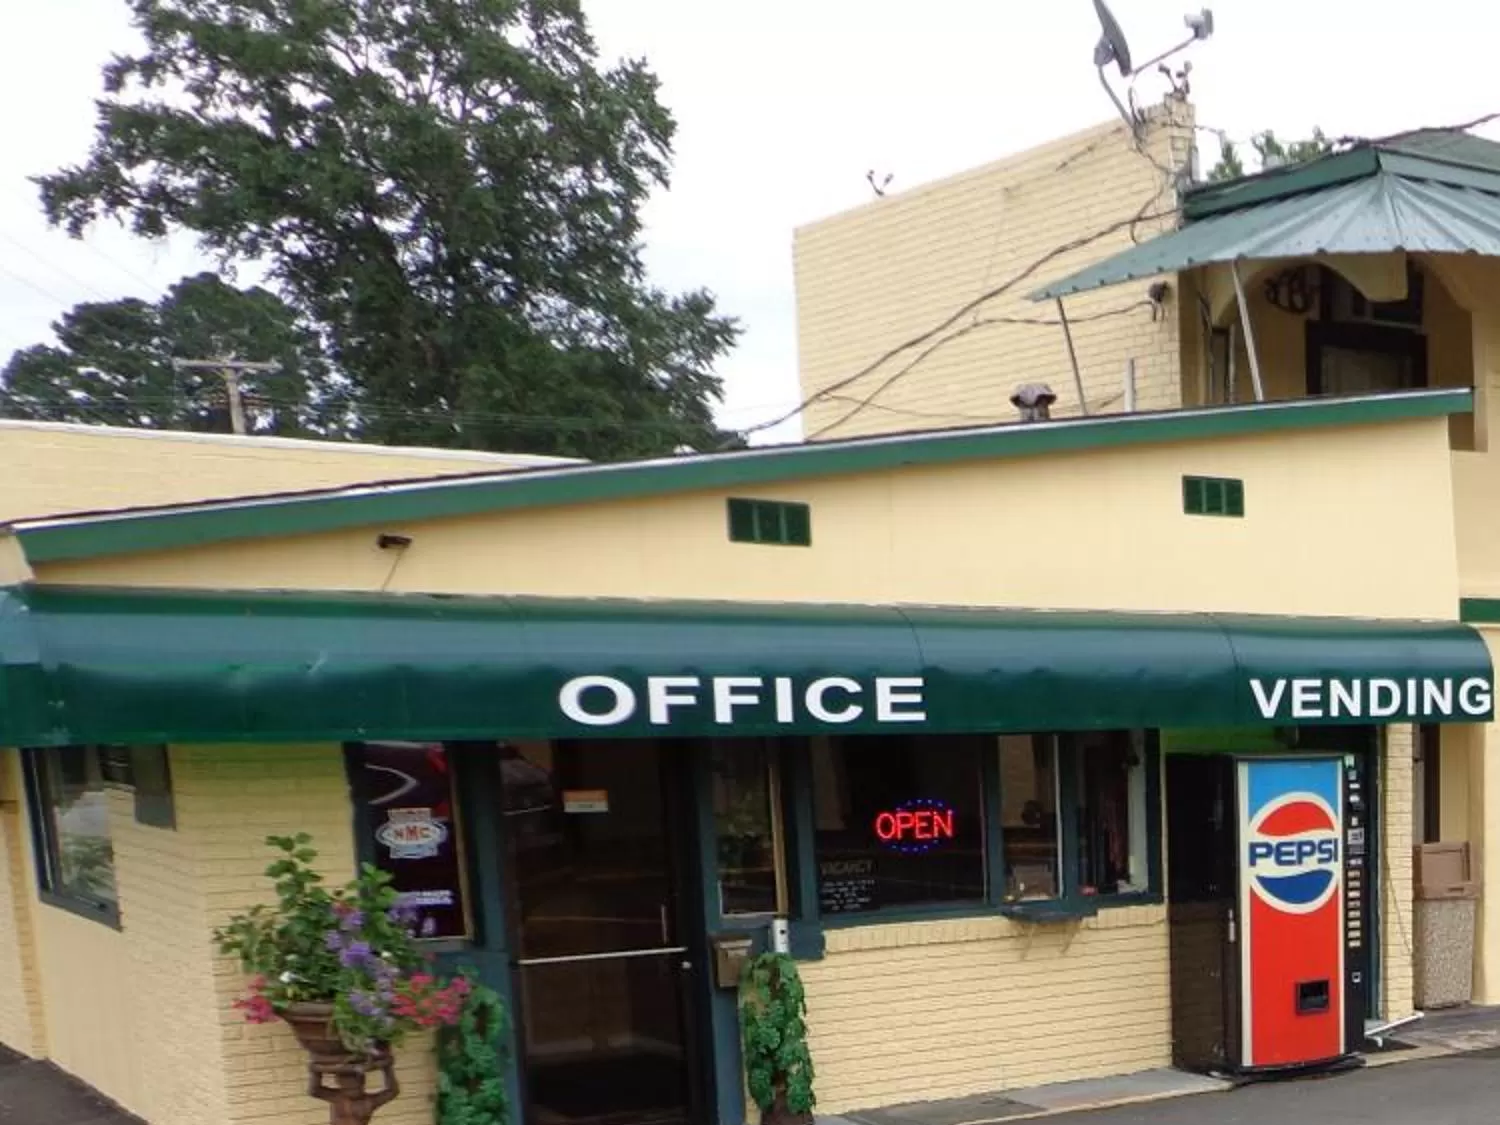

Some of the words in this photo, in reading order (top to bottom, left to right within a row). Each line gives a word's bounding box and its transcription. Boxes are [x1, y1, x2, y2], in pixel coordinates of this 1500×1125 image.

[558, 674, 927, 725] OFFICE
[1249, 677, 1492, 719] VENDING
[875, 809, 954, 840] OPEN
[1249, 838, 1339, 867] PEPSI
